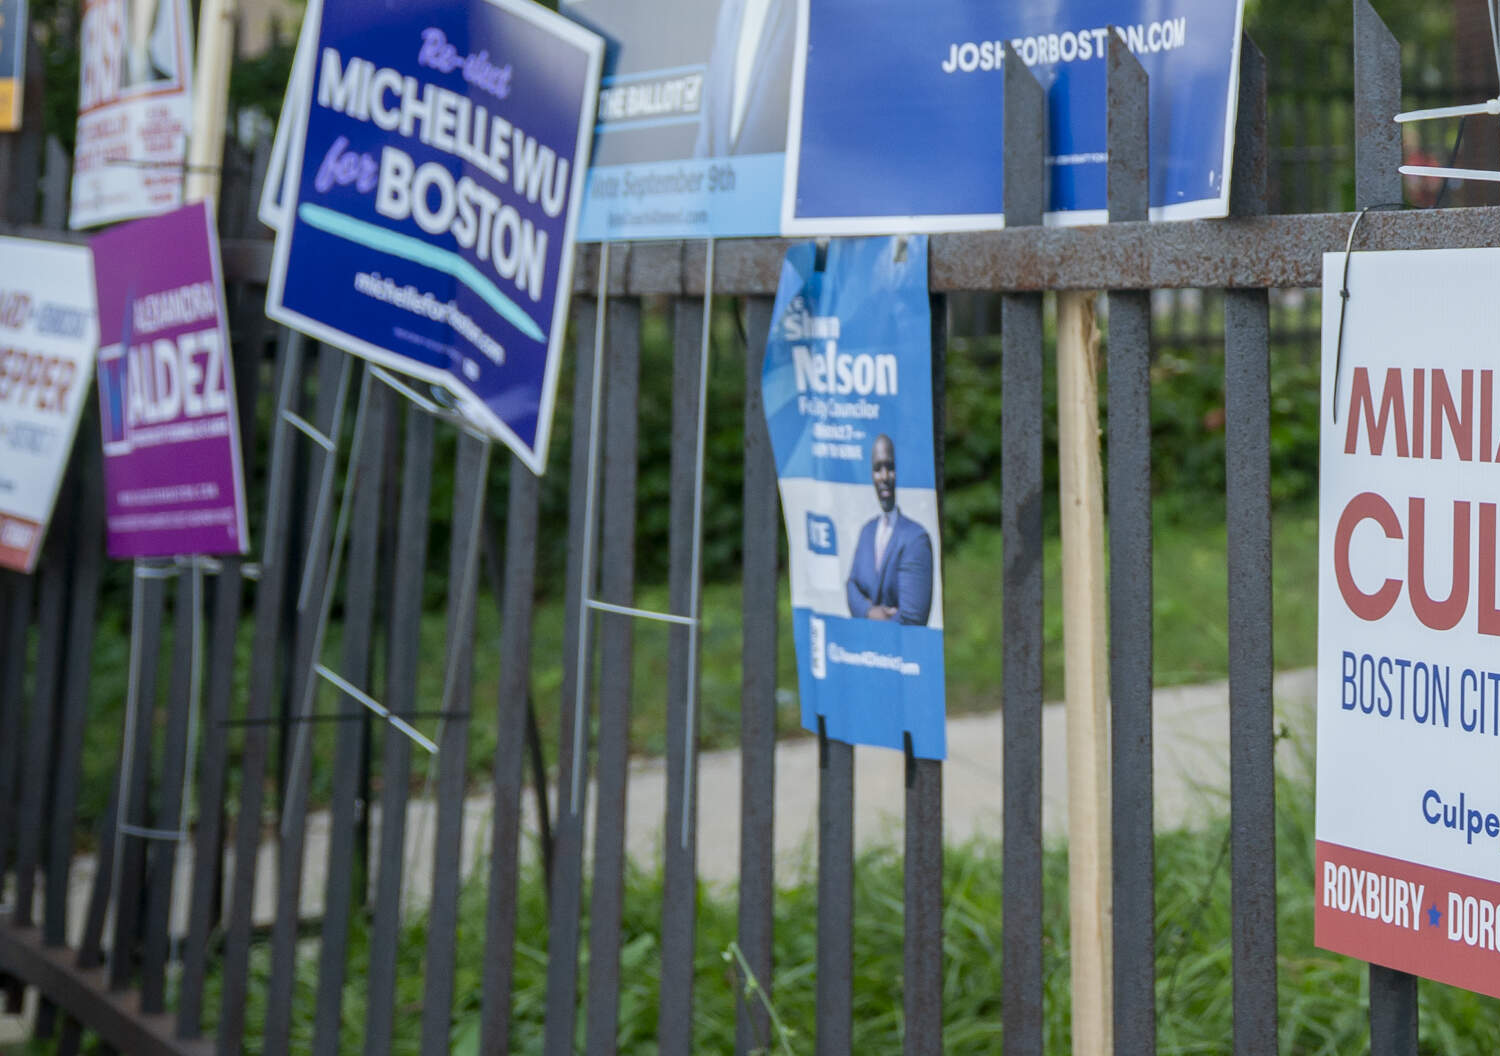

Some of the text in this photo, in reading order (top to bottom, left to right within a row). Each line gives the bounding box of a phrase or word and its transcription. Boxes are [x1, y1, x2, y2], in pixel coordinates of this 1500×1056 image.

[318, 47, 511, 184] MICHELLE
[511, 128, 569, 219] WU
[314, 136, 379, 194] for
[375, 144, 548, 302] BOSTON
[793, 340, 899, 396] Nelson
[1342, 650, 1450, 728] BOSTON
[1323, 860, 1425, 932] ROXBURY
